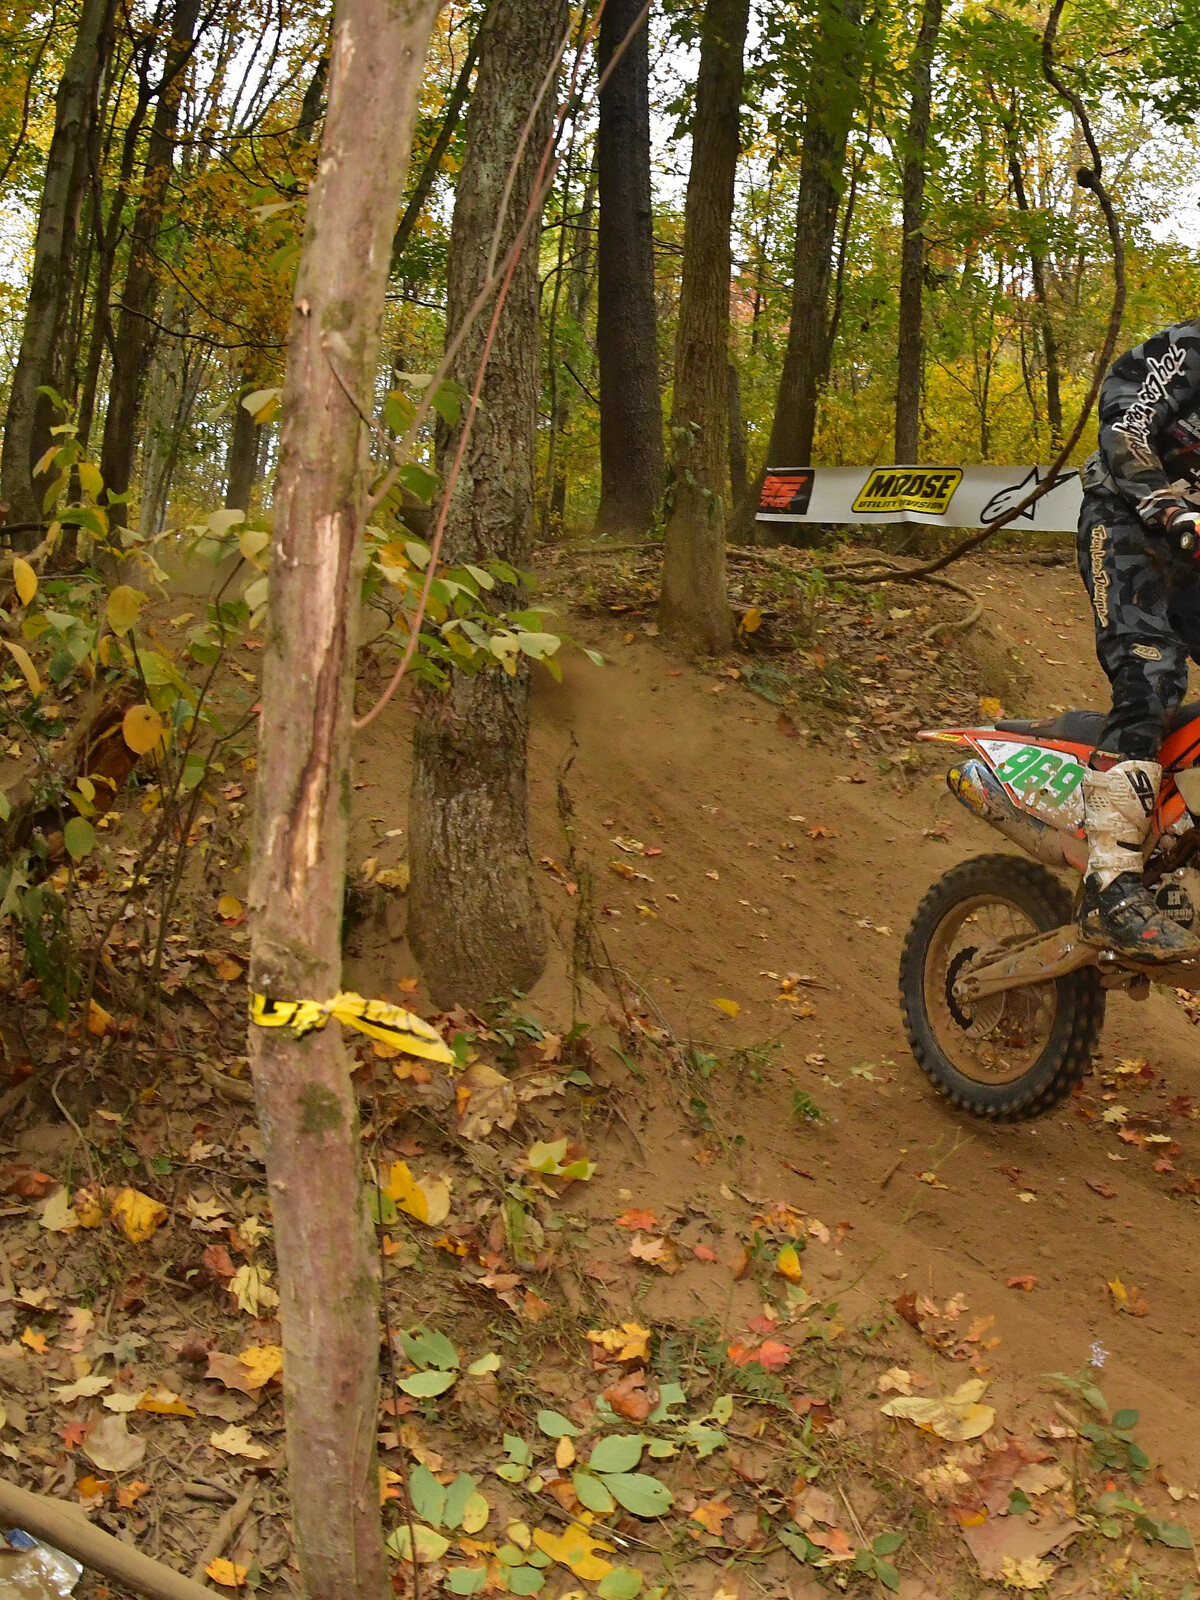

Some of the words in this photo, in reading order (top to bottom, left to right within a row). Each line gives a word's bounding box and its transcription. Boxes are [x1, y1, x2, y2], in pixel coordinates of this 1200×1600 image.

[864, 474, 956, 499] MOOSE
[858, 499, 897, 509] UTILITY
[898, 499, 945, 511] DIVISION
[994, 745, 1086, 808] 969
[1161, 908, 1193, 919] INSON
